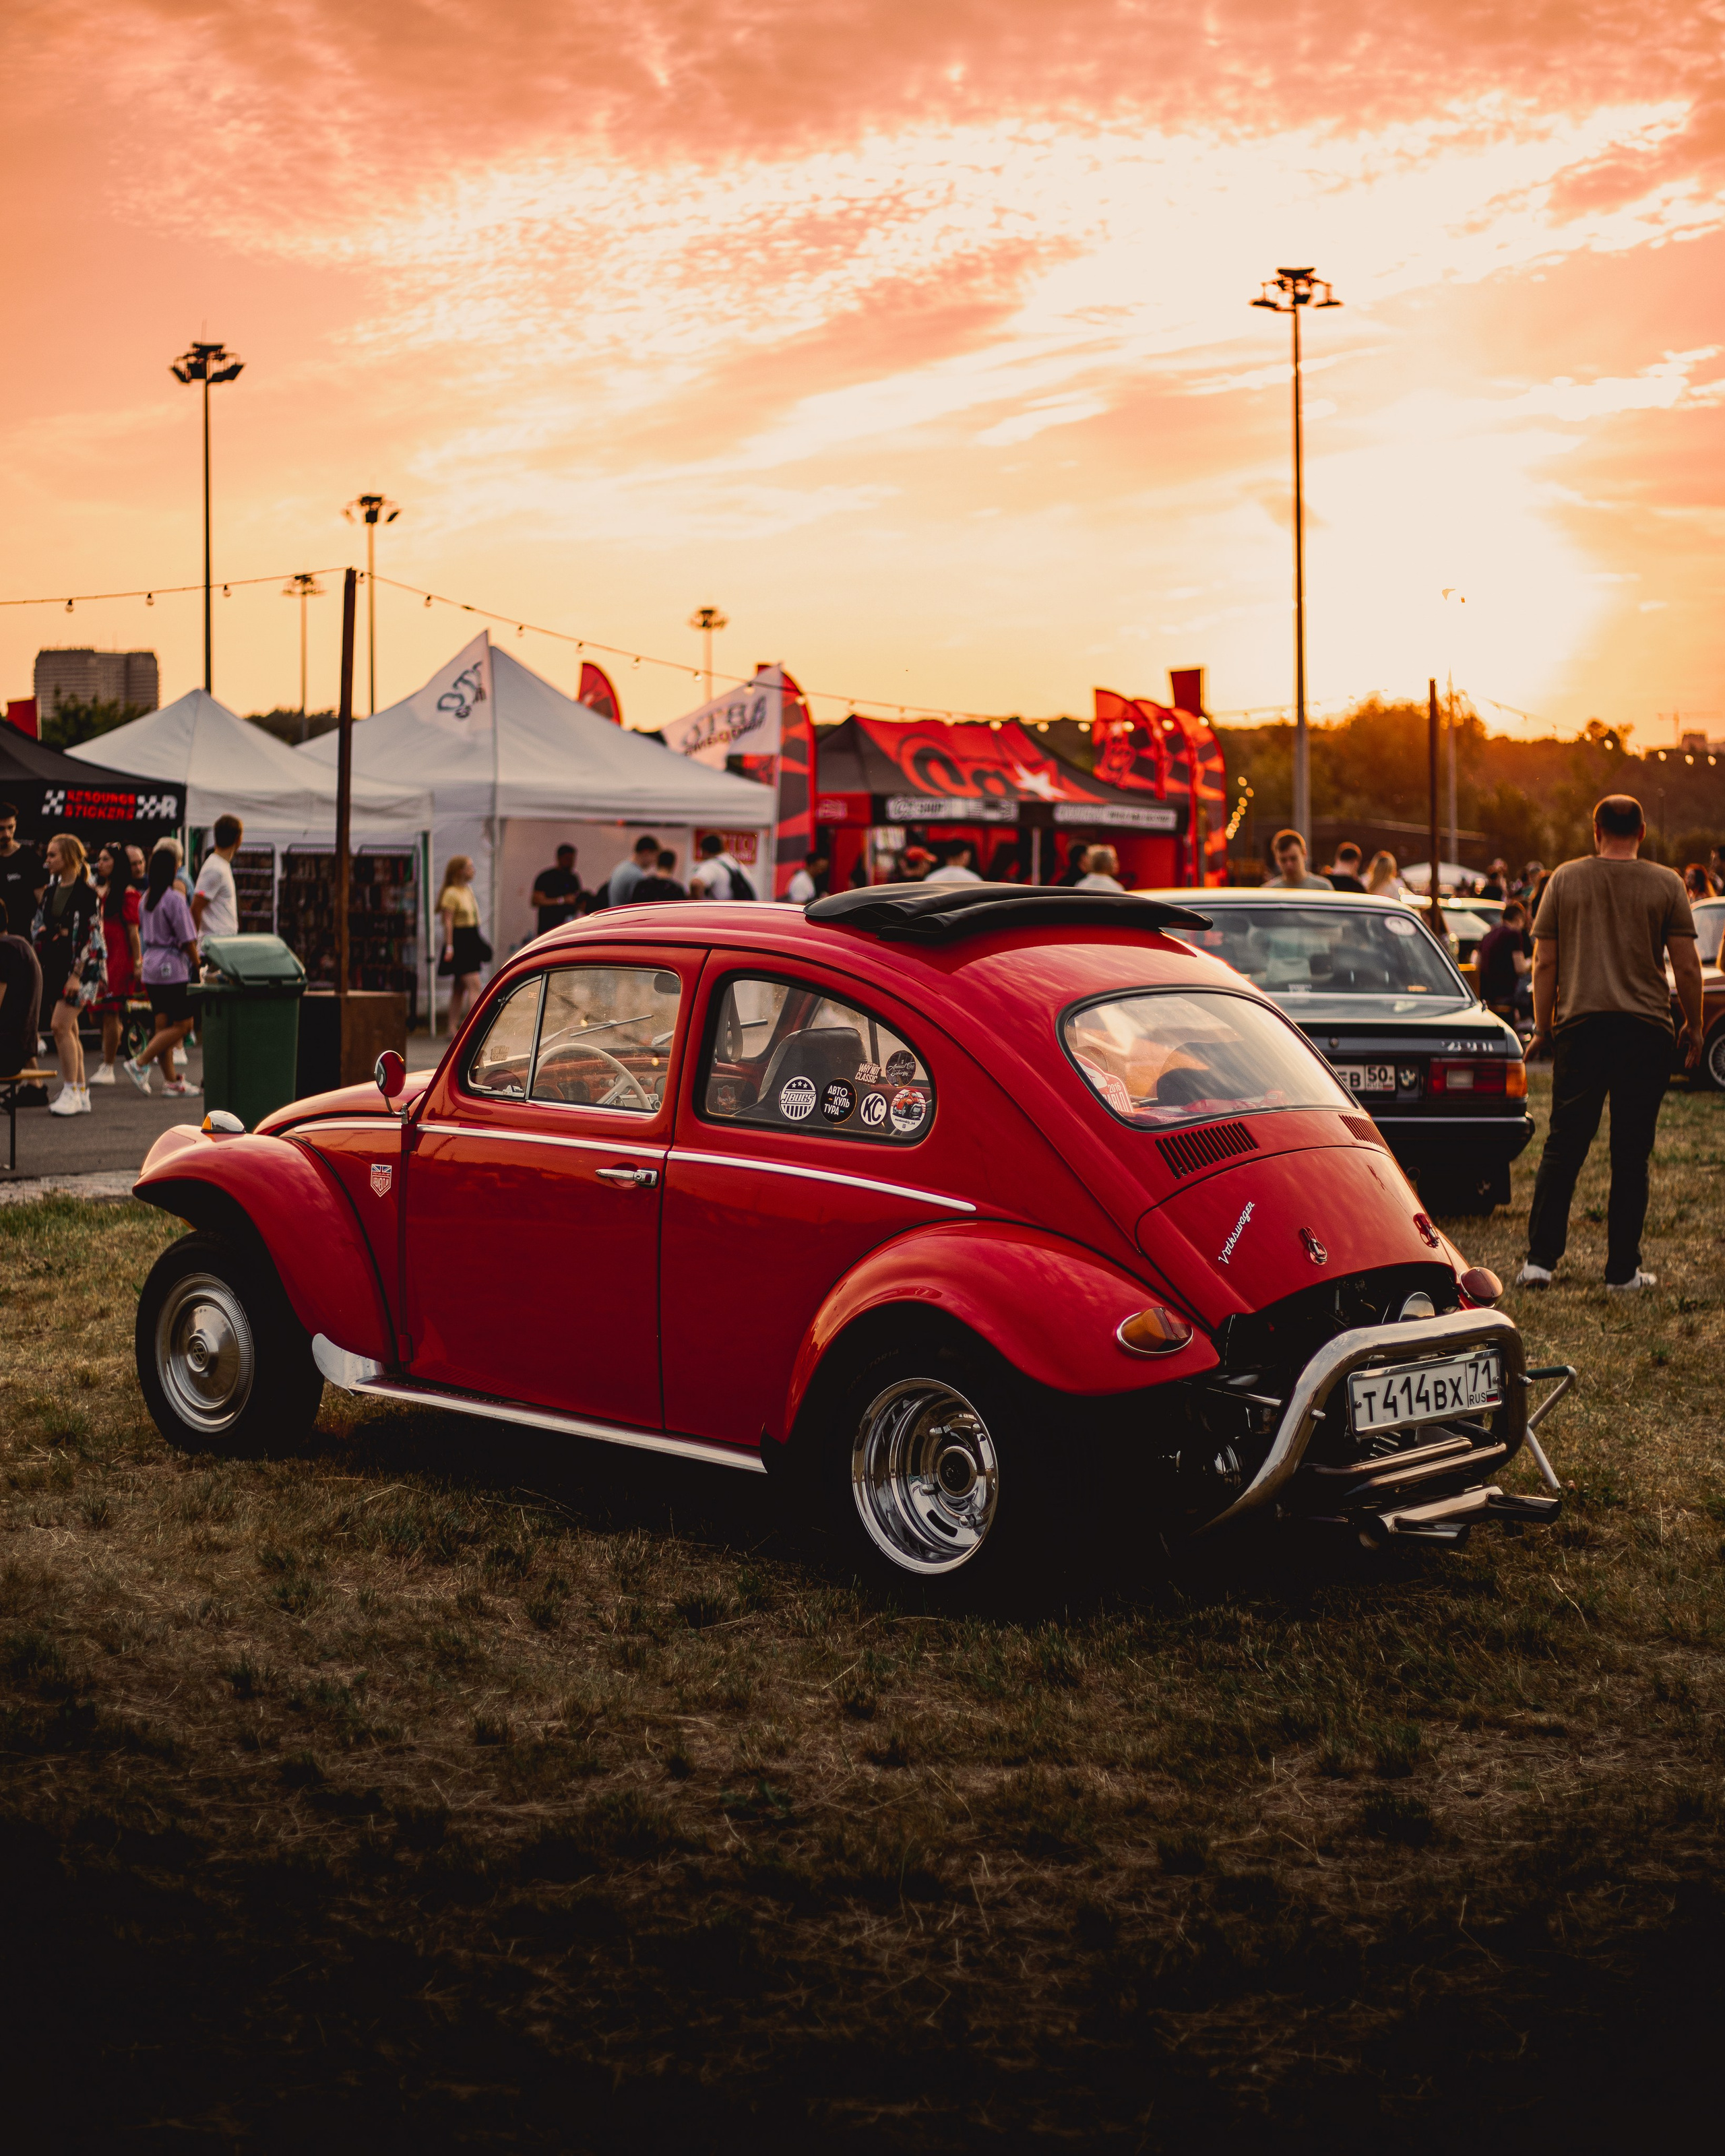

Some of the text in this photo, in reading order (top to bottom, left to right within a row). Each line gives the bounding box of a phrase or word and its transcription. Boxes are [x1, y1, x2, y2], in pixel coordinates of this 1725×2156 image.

[64, 803, 135, 821] STICKERS
[858, 1063, 872, 1073] WHY
[869, 1066, 881, 1075] NOT
[1367, 1067, 1387, 1082] 50
[854, 1072, 878, 1083] CLASSIC
[827, 1085, 848, 1098] АВТО
[1107, 1081, 1121, 1093] 2016
[781, 1091, 816, 1105] JBUGS
[862, 1095, 884, 1122] KC
[1218, 1201, 1255, 1264] Volkswagen
[1469, 1360, 1492, 1393] 71
[1469, 1392, 1486, 1405] RUS
